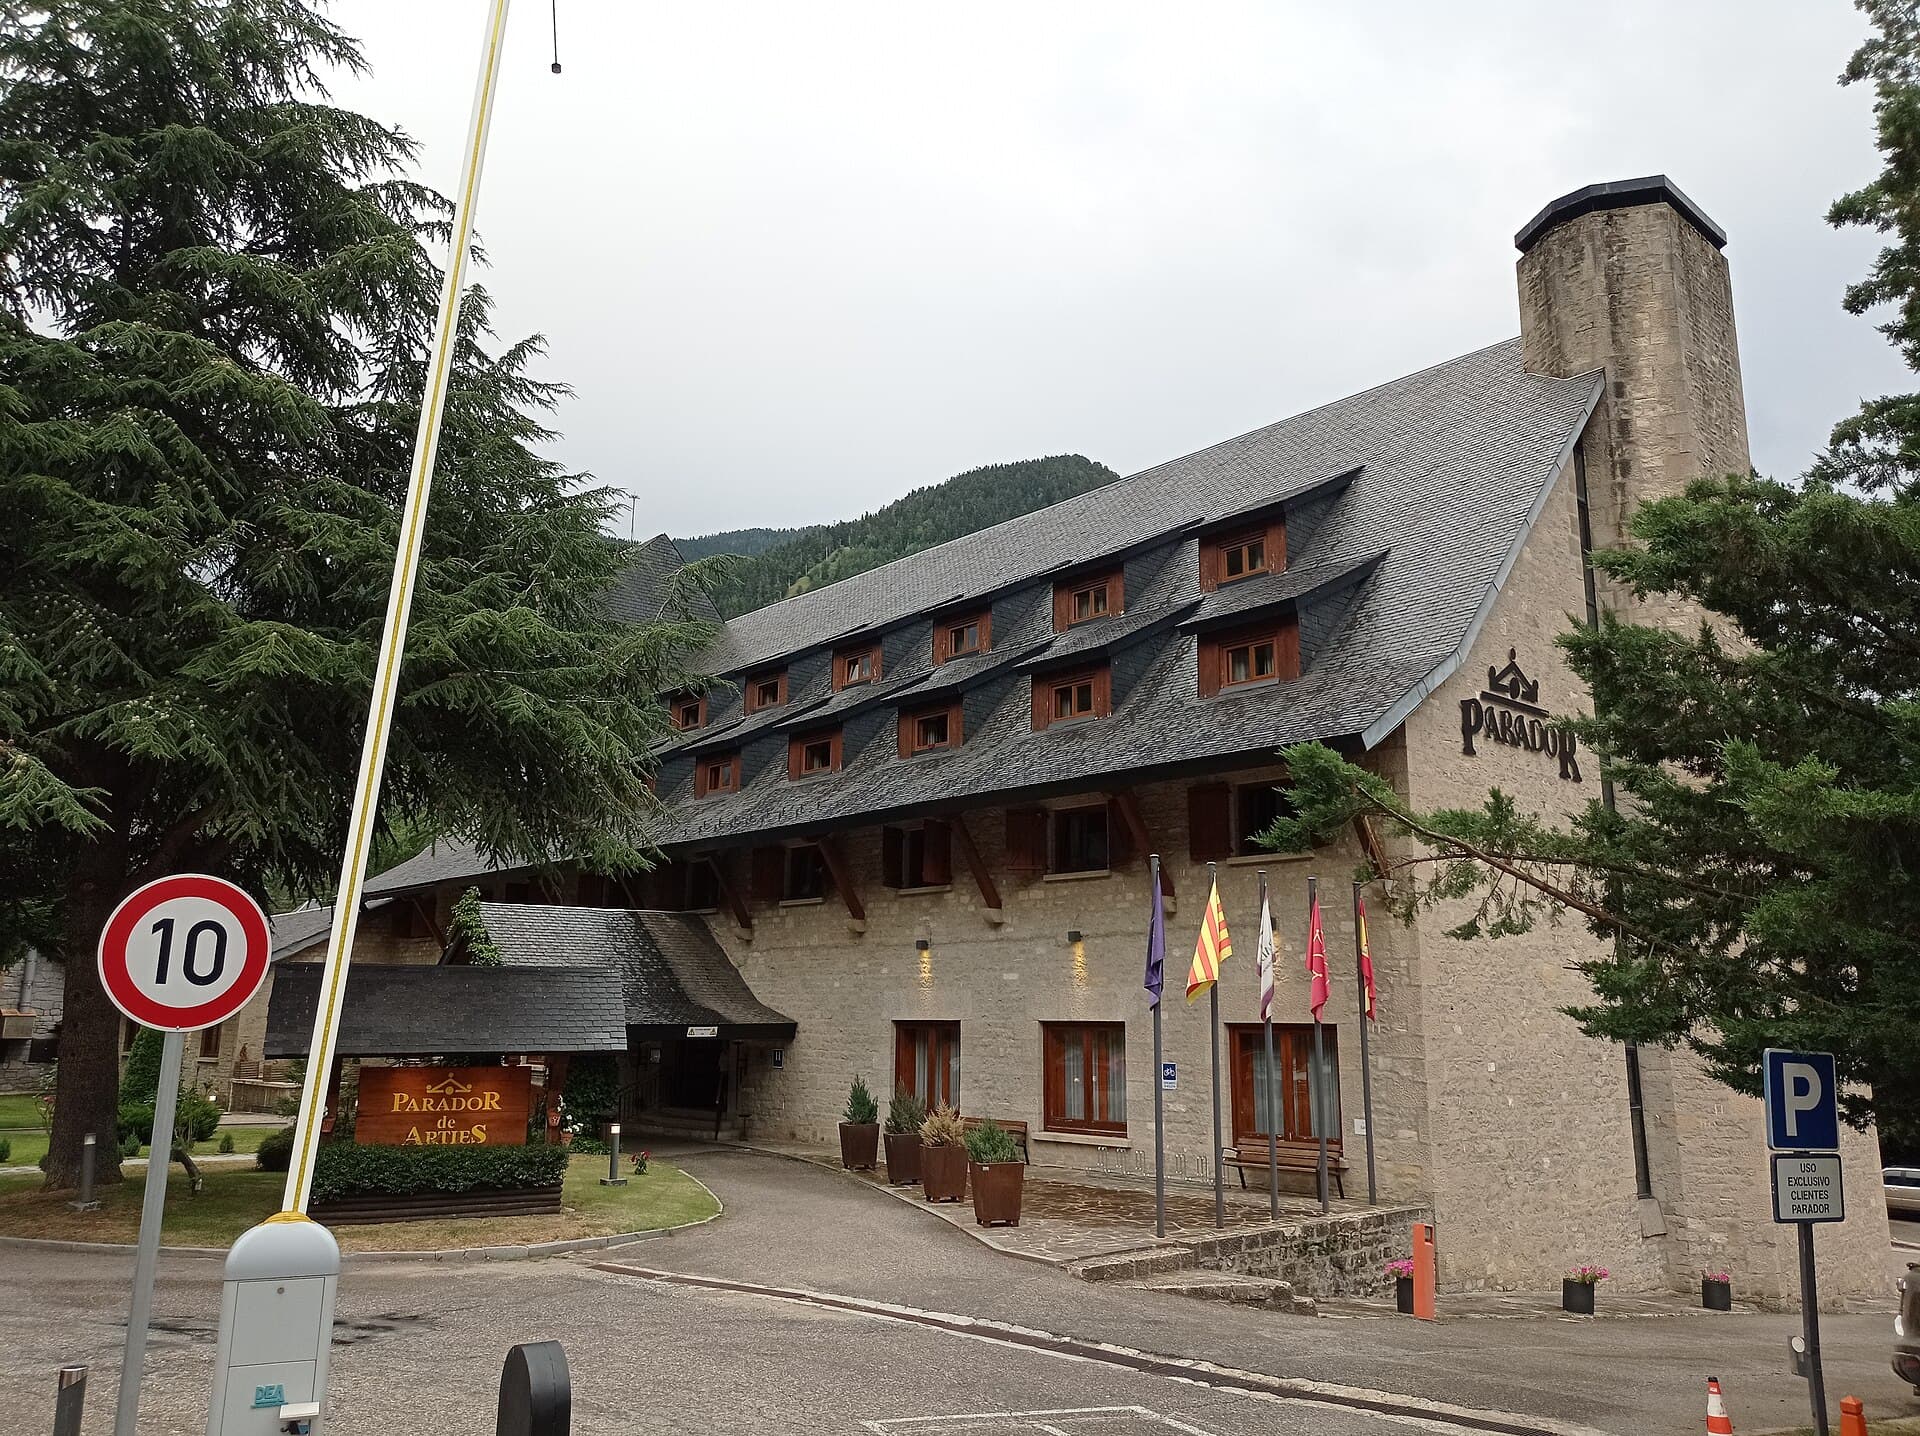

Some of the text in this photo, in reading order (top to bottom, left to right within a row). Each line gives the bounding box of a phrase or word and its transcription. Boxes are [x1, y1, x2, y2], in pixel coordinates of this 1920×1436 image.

[1460, 697, 1583, 783] PARADOR
[151, 918, 228, 986] 10
[391, 1091, 502, 1112] PARADOR
[1782, 1062, 1822, 1137] P
[436, 1116, 456, 1129] de
[1800, 1163, 1817, 1173] USO
[1787, 1176, 1831, 1187] EXCLUSIVO
[1790, 1189, 1829, 1201] CLIENTES
[1791, 1203, 1830, 1215] PARADOR
[255, 1385, 286, 1402] DEA
